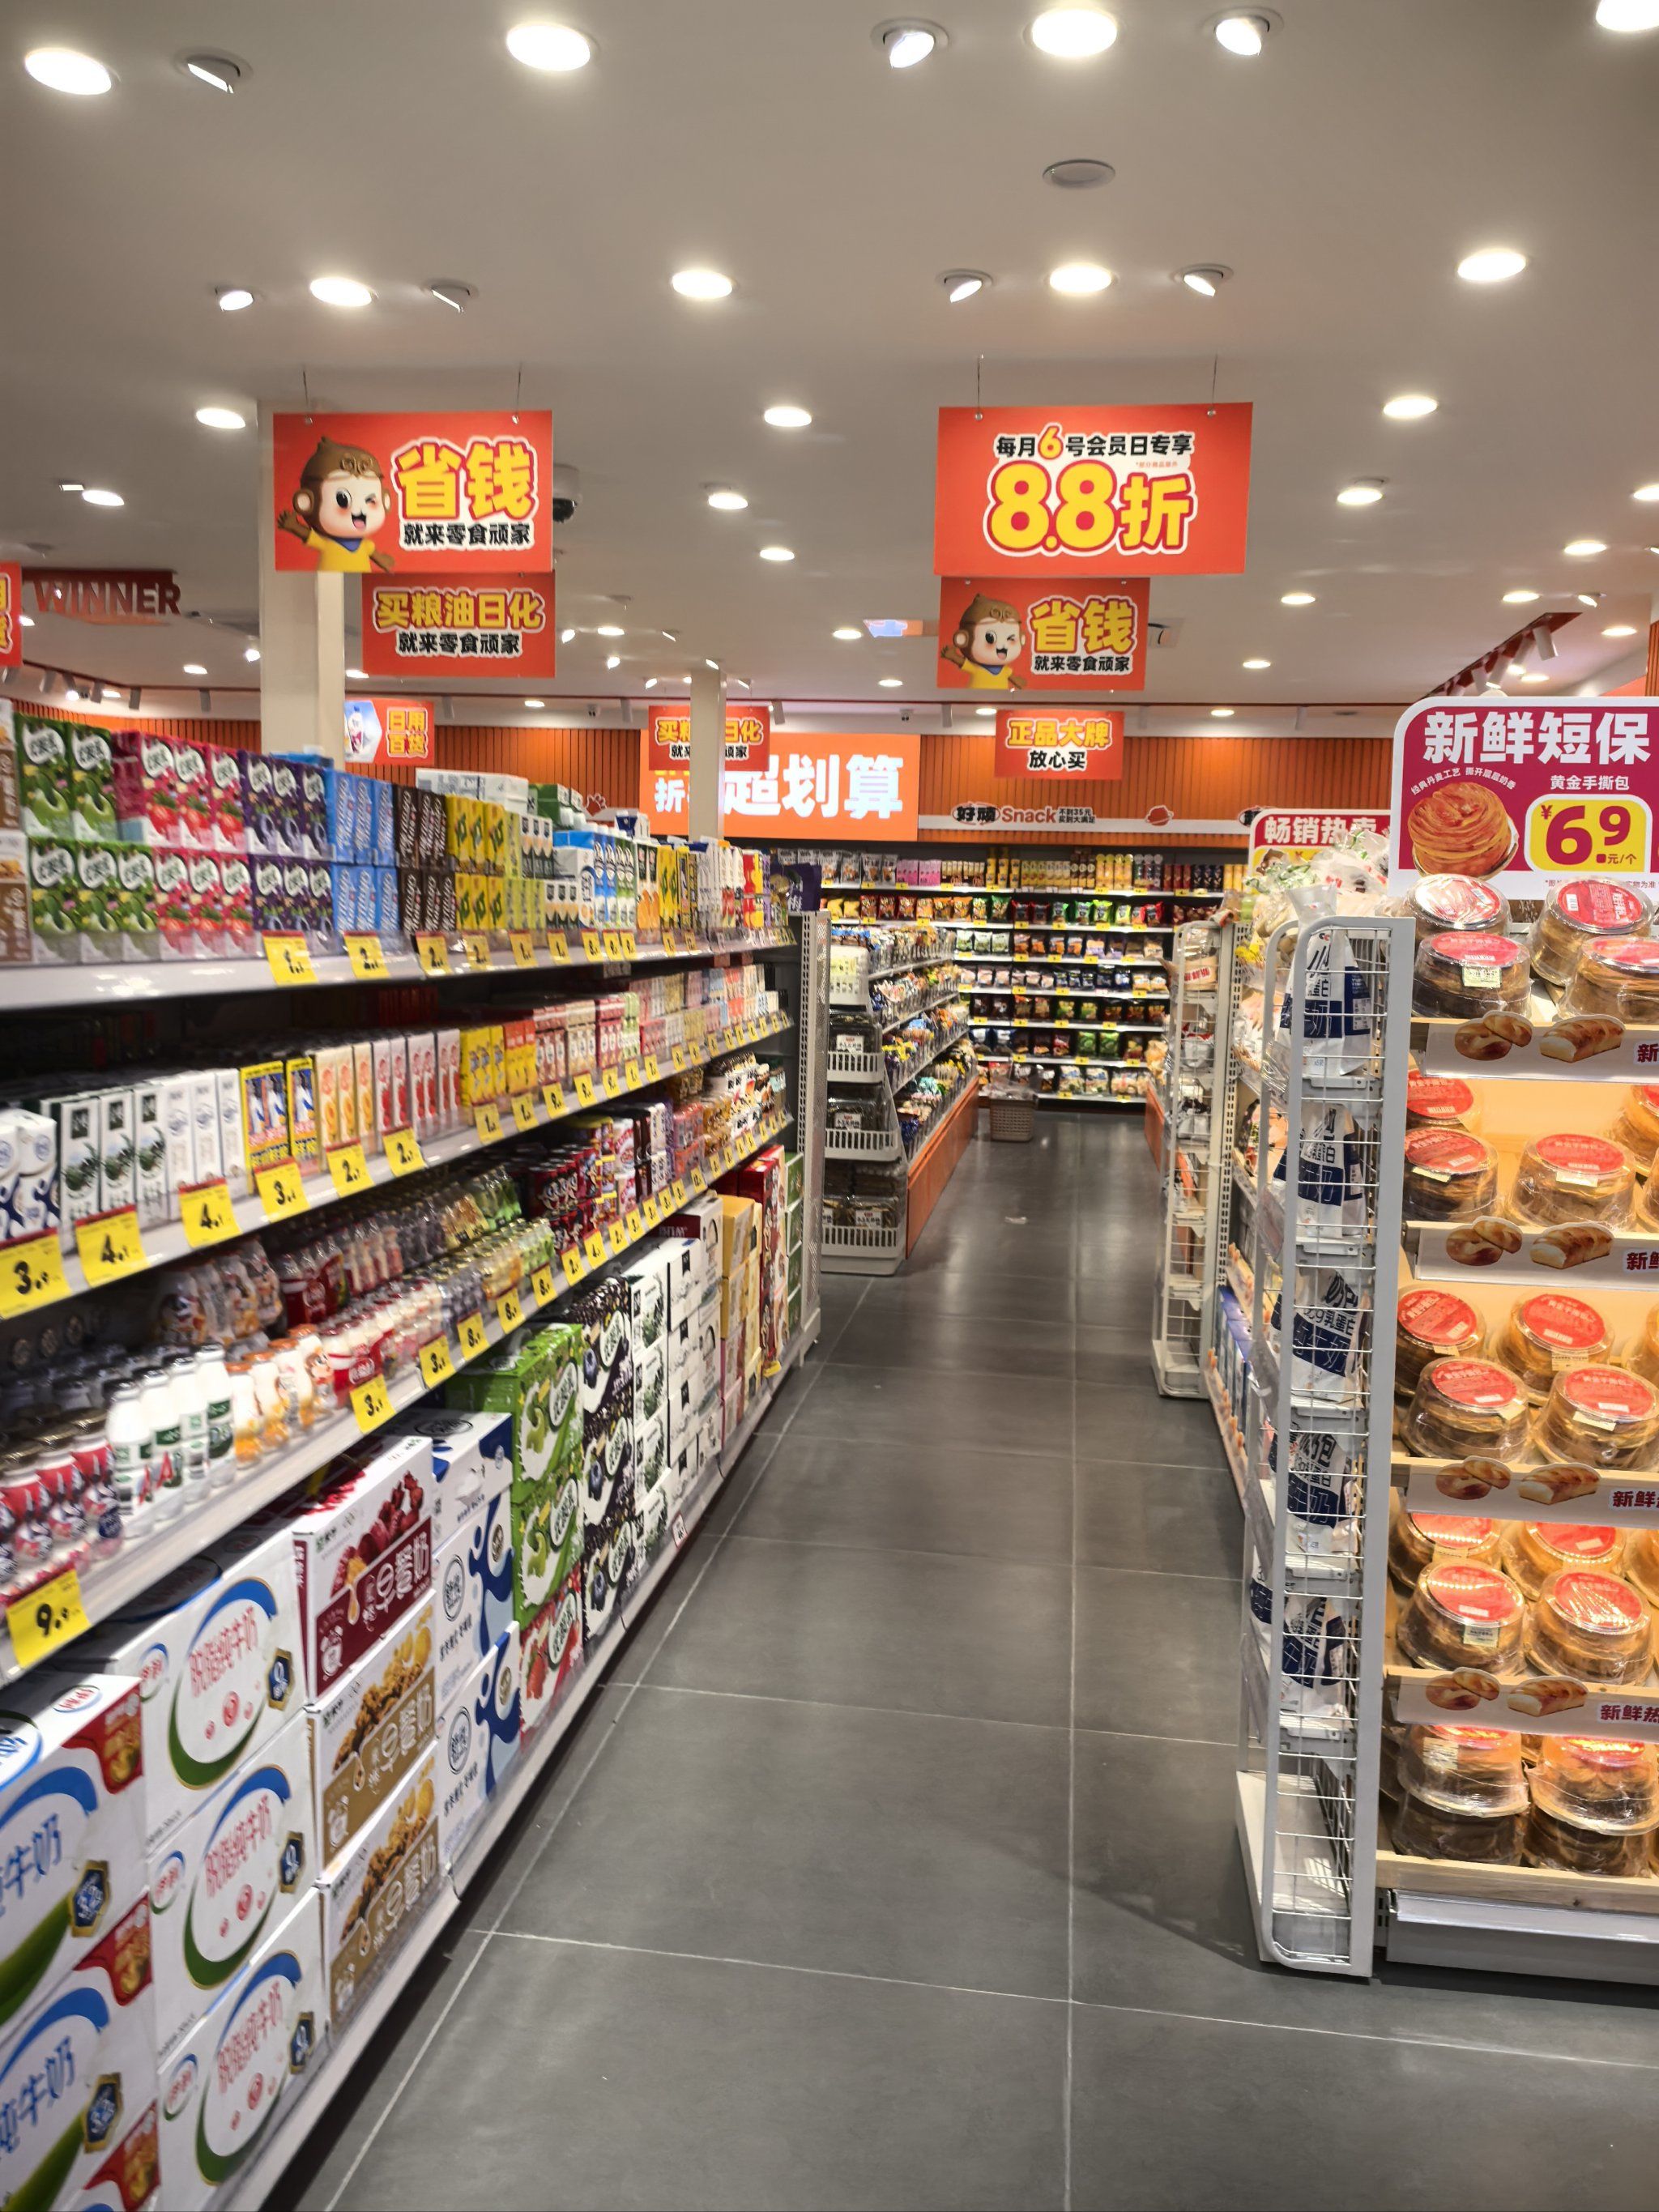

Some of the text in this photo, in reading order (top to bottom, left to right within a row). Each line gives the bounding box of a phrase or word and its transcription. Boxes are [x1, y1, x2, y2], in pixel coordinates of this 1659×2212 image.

[996, 424, 1192, 459] 每月6号会员日专享
[394, 441, 535, 518] 省钱
[988, 460, 1192, 551] 8.8折
[404, 523, 530, 545] 就来零食顽家
[34, 582, 181, 615] WINNER
[375, 591, 541, 629] 买粮油日化
[1031, 599, 1134, 653] 省钱
[399, 633, 520, 654] 就来零食顽家
[1034, 656, 1130, 671] 就来零食顽家
[1009, 719, 1111, 747] 正品大牌
[1423, 711, 1651, 765] 新鲜短保
[1029, 750, 1086, 769] 放心买
[724, 754, 903, 819] 超划算
[1550, 775, 1630, 791] 黄金手撕包
[1001, 808, 1056, 824] Snack
[1607, 854, 1637, 864] 元/个
